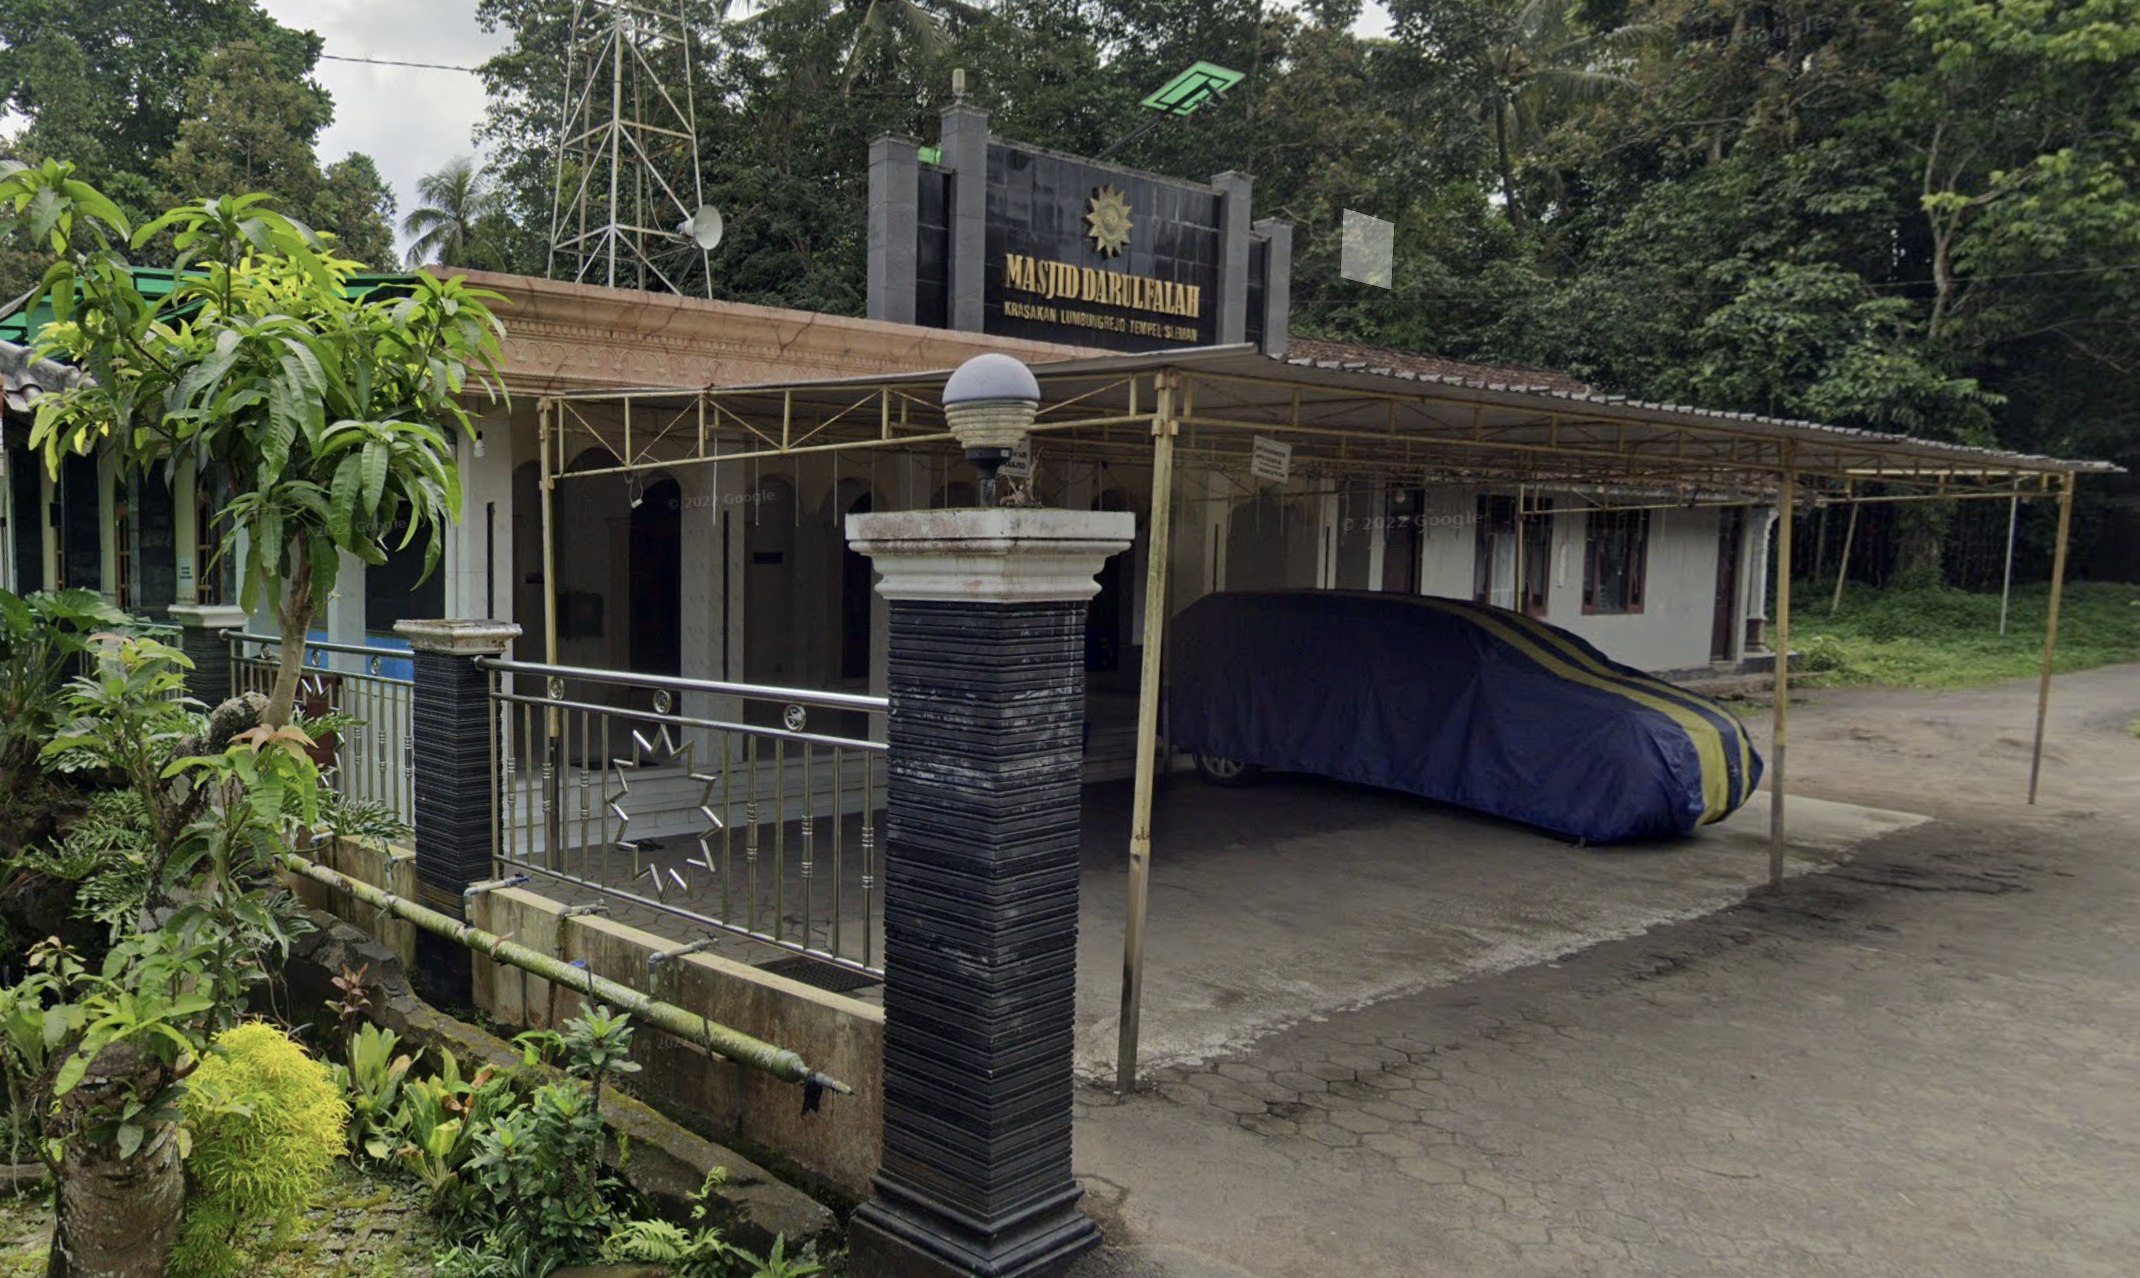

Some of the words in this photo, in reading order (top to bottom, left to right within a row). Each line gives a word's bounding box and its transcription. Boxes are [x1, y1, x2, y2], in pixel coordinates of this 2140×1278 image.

[1006, 253, 1080, 299] MASJID
[1004, 301, 1057, 323] KRASAKAN
[1061, 310, 1126, 333] LUMBUNGREJO
[1130, 320, 1162, 338] TEMPEL
[1164, 324, 1198, 342] SLEMAN
